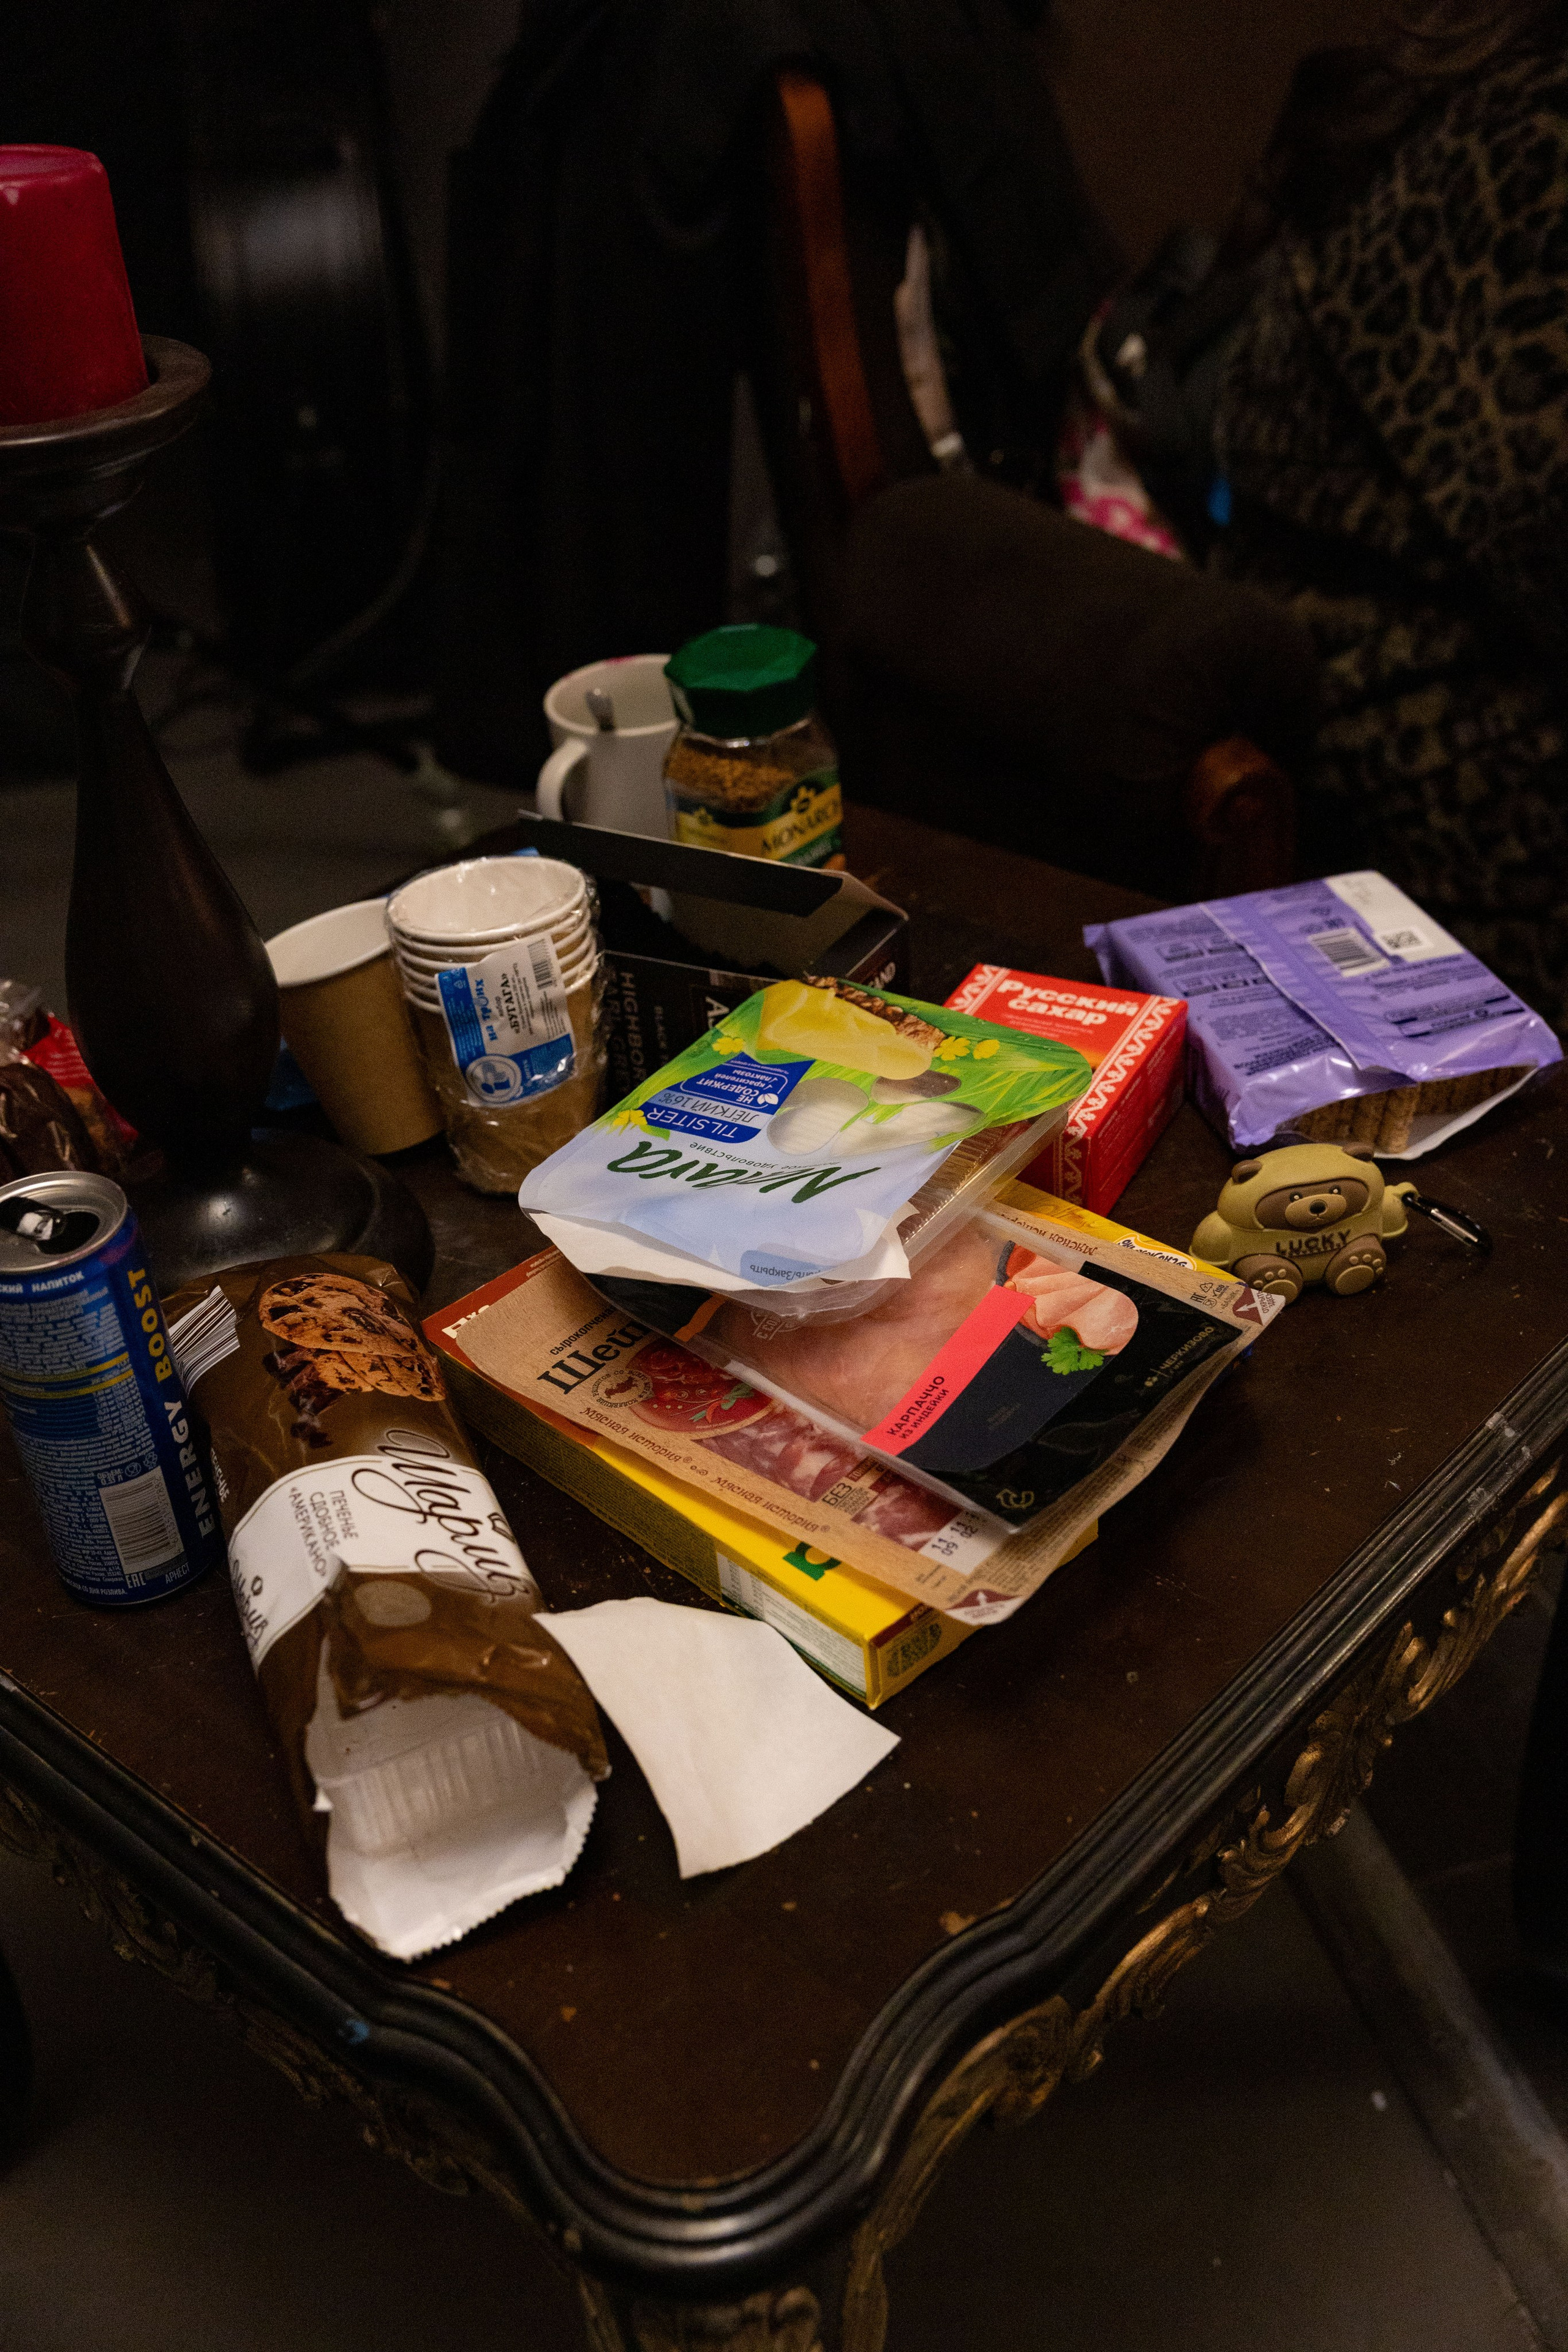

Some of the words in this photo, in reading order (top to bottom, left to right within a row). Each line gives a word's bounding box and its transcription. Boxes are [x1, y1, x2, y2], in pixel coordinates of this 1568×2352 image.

[997, 979, 1139, 1017] Русский
[1008, 1000, 1107, 1025] сахар
[696, 1077, 760, 1097] СОДЕРЖИТ
[715, 1073, 766, 1088] красителей
[733, 1069, 771, 1081] лактозы
[690, 1100, 760, 1123] ЛЁГКИЙ
[736, 1095, 754, 1104] НЕ
[647, 1107, 739, 1138] TILSITER
[690, 1142, 776, 1169] удовольствие
[1048, 1233, 1098, 1256] Мясная
[1275, 1229, 1351, 1256] LUCKY
[32, 1271, 85, 1292] НАПИТОК
[127, 1267, 173, 1384] BOOST
[1159, 1326, 1214, 1372] ЧЕРКИЗОВО
[886, 1374, 946, 1438] КАРПАЧЧО
[579, 1406, 629, 1437] Мясная
[164, 1400, 215, 1539] ENERGY
[711, 1476, 763, 1506] Мясная
[821, 1481, 854, 1507] БЕЗ
[309, 1491, 340, 1551] СДОБНОЕ
[330, 1489, 359, 1539] ПЕЧЕНЬЕ
[288, 1485, 328, 1578] «АМЕРИКАНО»
[165, 1562, 191, 1585] АРНЕСТ
